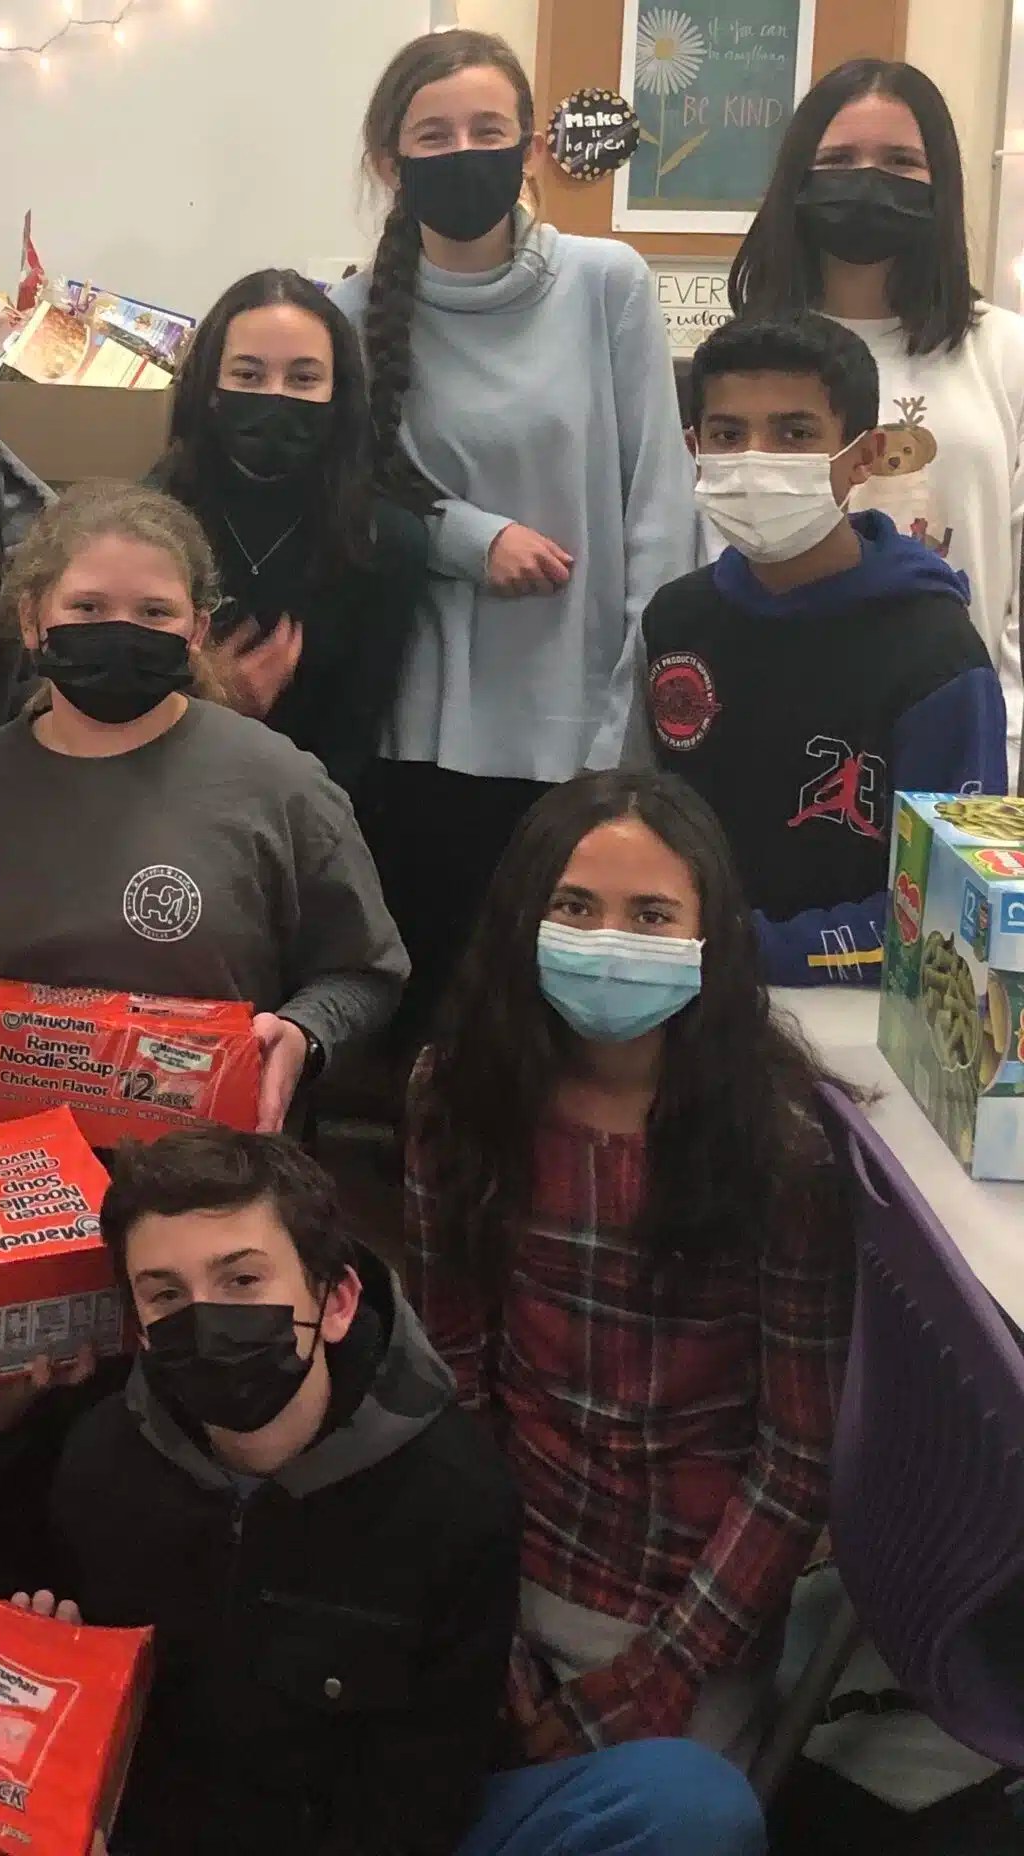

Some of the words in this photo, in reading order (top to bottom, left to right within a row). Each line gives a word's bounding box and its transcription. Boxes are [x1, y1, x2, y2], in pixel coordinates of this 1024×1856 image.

[565, 112, 623, 128] Make
[724, 95, 783, 128] KIND
[591, 129, 602, 138] it
[566, 135, 625, 160] happen
[20, 1012, 97, 1034] Maruchan
[26, 1034, 91, 1057] Ramen
[66, 1055, 115, 1079] Soup
[0, 1070, 61, 1091] Chicken
[62, 1078, 109, 1098] Flavor
[118, 1068, 156, 1104] 12
[1, 1172, 63, 1196] Soup
[4, 1198, 91, 1223] Ramen
